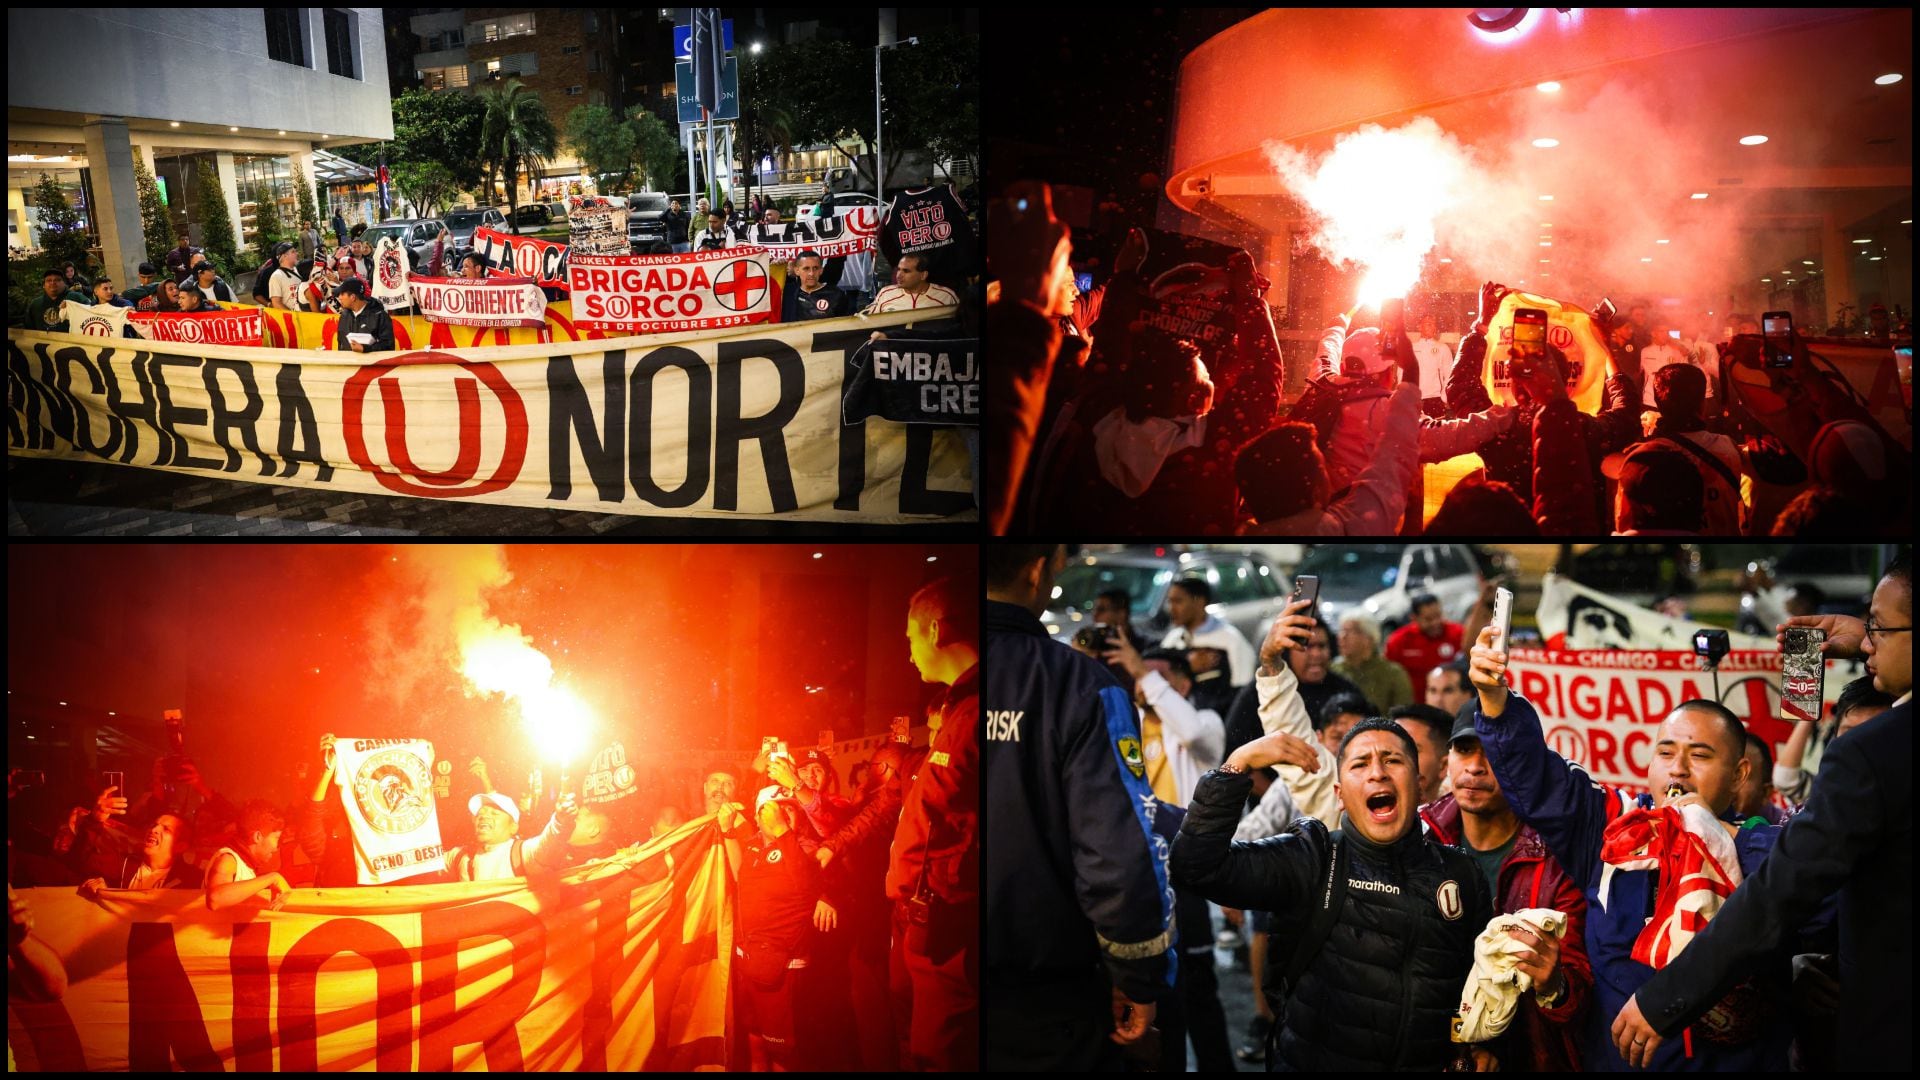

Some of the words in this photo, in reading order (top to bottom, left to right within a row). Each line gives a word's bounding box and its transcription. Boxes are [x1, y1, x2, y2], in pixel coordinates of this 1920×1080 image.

[572, 256, 615, 265] RUKELY
[635, 255, 681, 265] CHANGO
[696, 247, 764, 261] CABALLITO
[811, 240, 858, 257] NORTE
[570, 266, 711, 292] BRIGADA
[465, 288, 525, 314] ORIENTE
[201, 315, 259, 343] NORTE
[593, 321, 609, 330] 18
[616, 321, 633, 330] DE
[641, 318, 708, 330] OCTUBRE
[715, 315, 751, 326] 1991
[873, 352, 979, 381] EMBAJ
